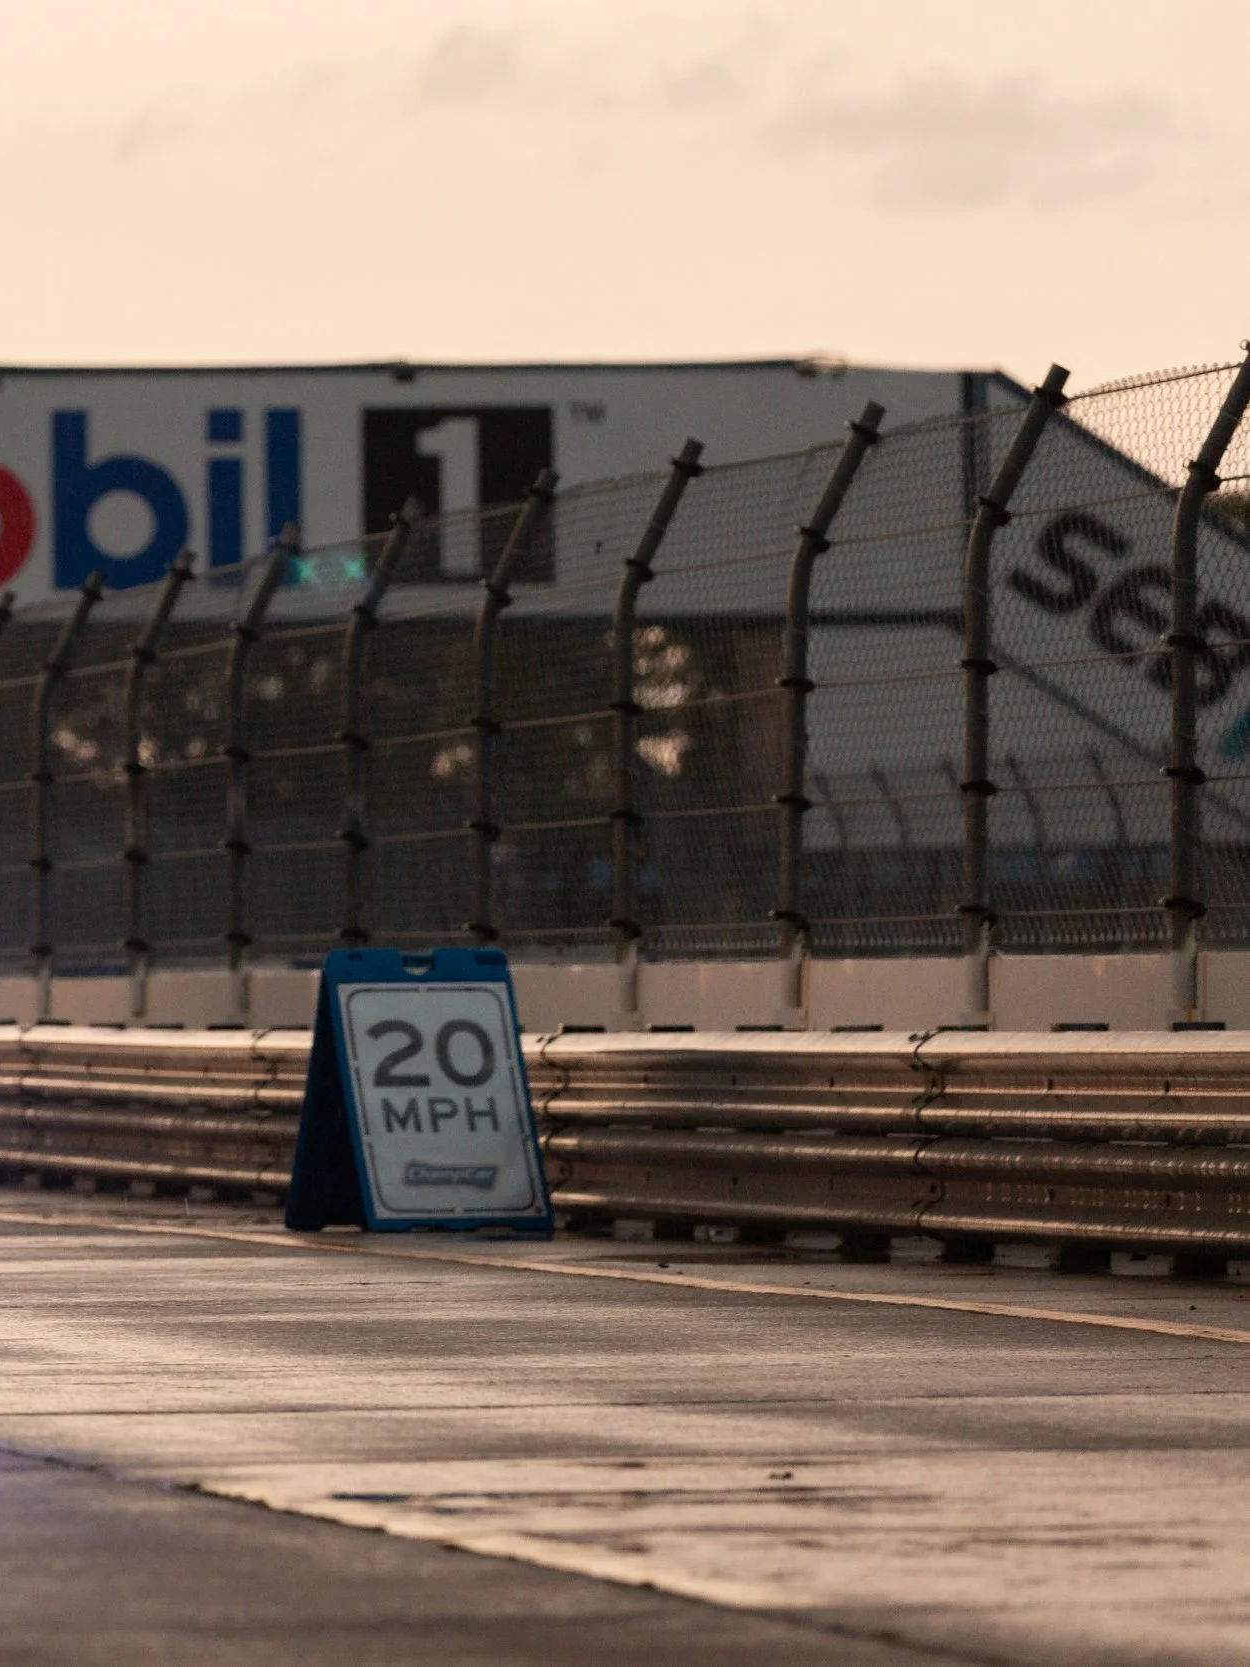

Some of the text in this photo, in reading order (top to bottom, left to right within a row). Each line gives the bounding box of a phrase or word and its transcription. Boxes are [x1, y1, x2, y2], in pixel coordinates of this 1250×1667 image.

[414, 415, 481, 579] 1
[366, 1019, 495, 1088] 20
[381, 1097, 500, 1133] MPH
